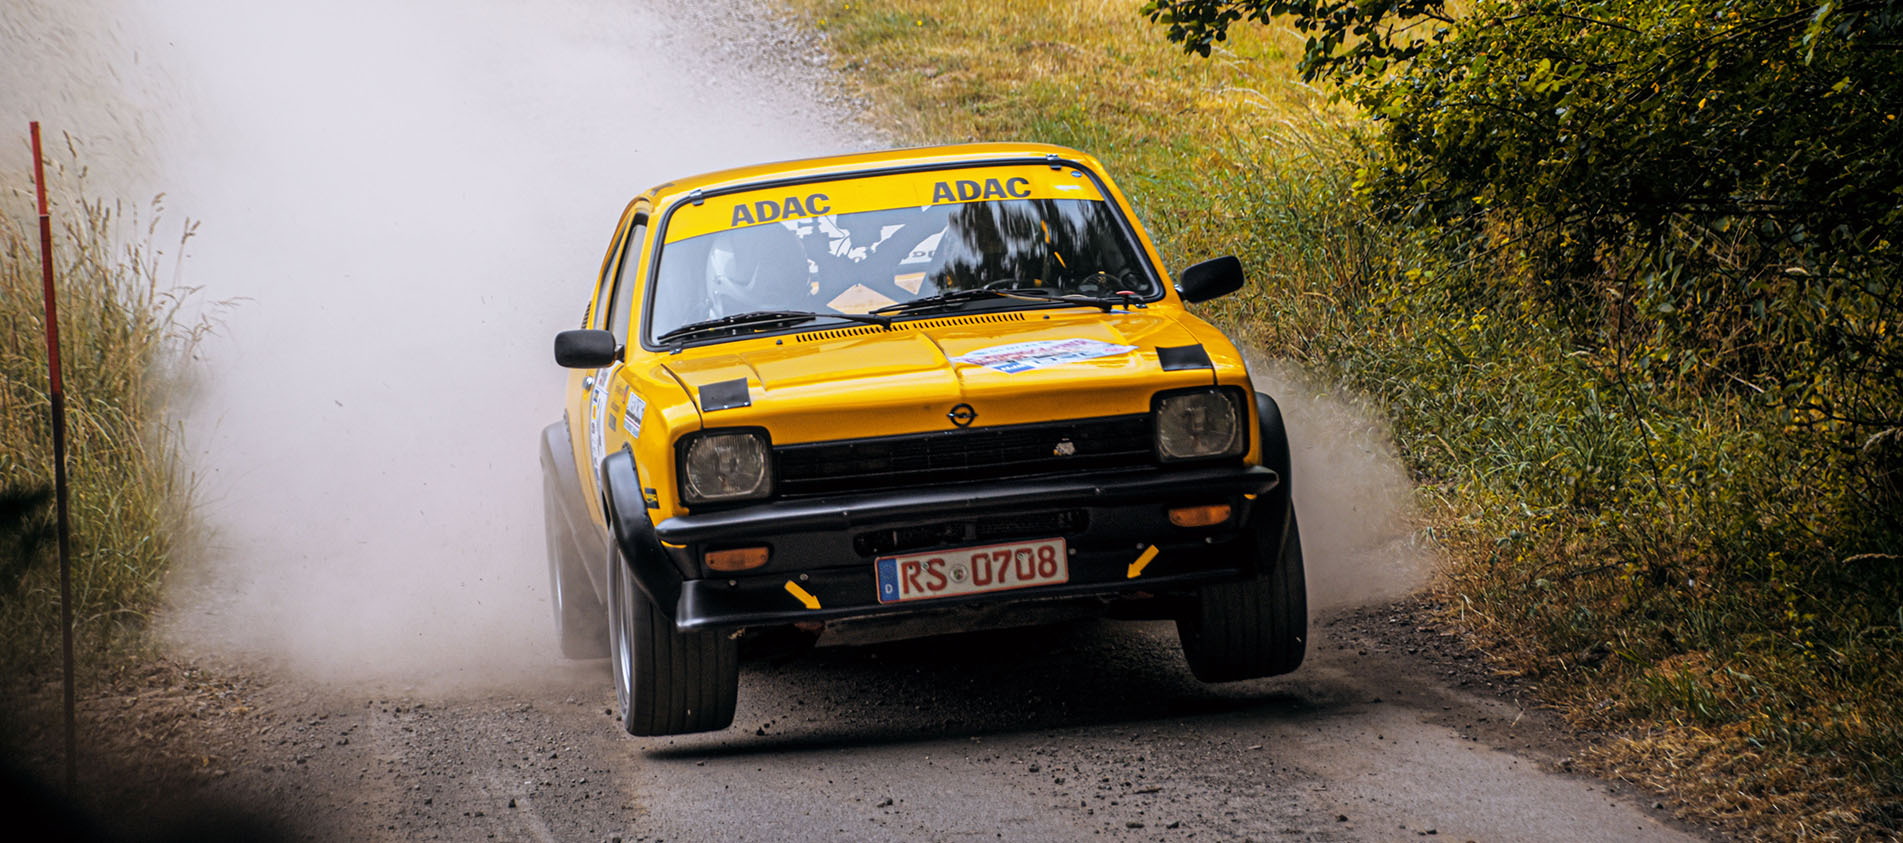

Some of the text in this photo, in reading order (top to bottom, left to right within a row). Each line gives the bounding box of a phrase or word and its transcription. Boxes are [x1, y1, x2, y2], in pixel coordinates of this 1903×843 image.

[932, 176, 1032, 204] ADAC
[731, 193, 831, 227] ADAC
[900, 545, 1058, 594] RS 0708
[884, 584, 893, 595] D
